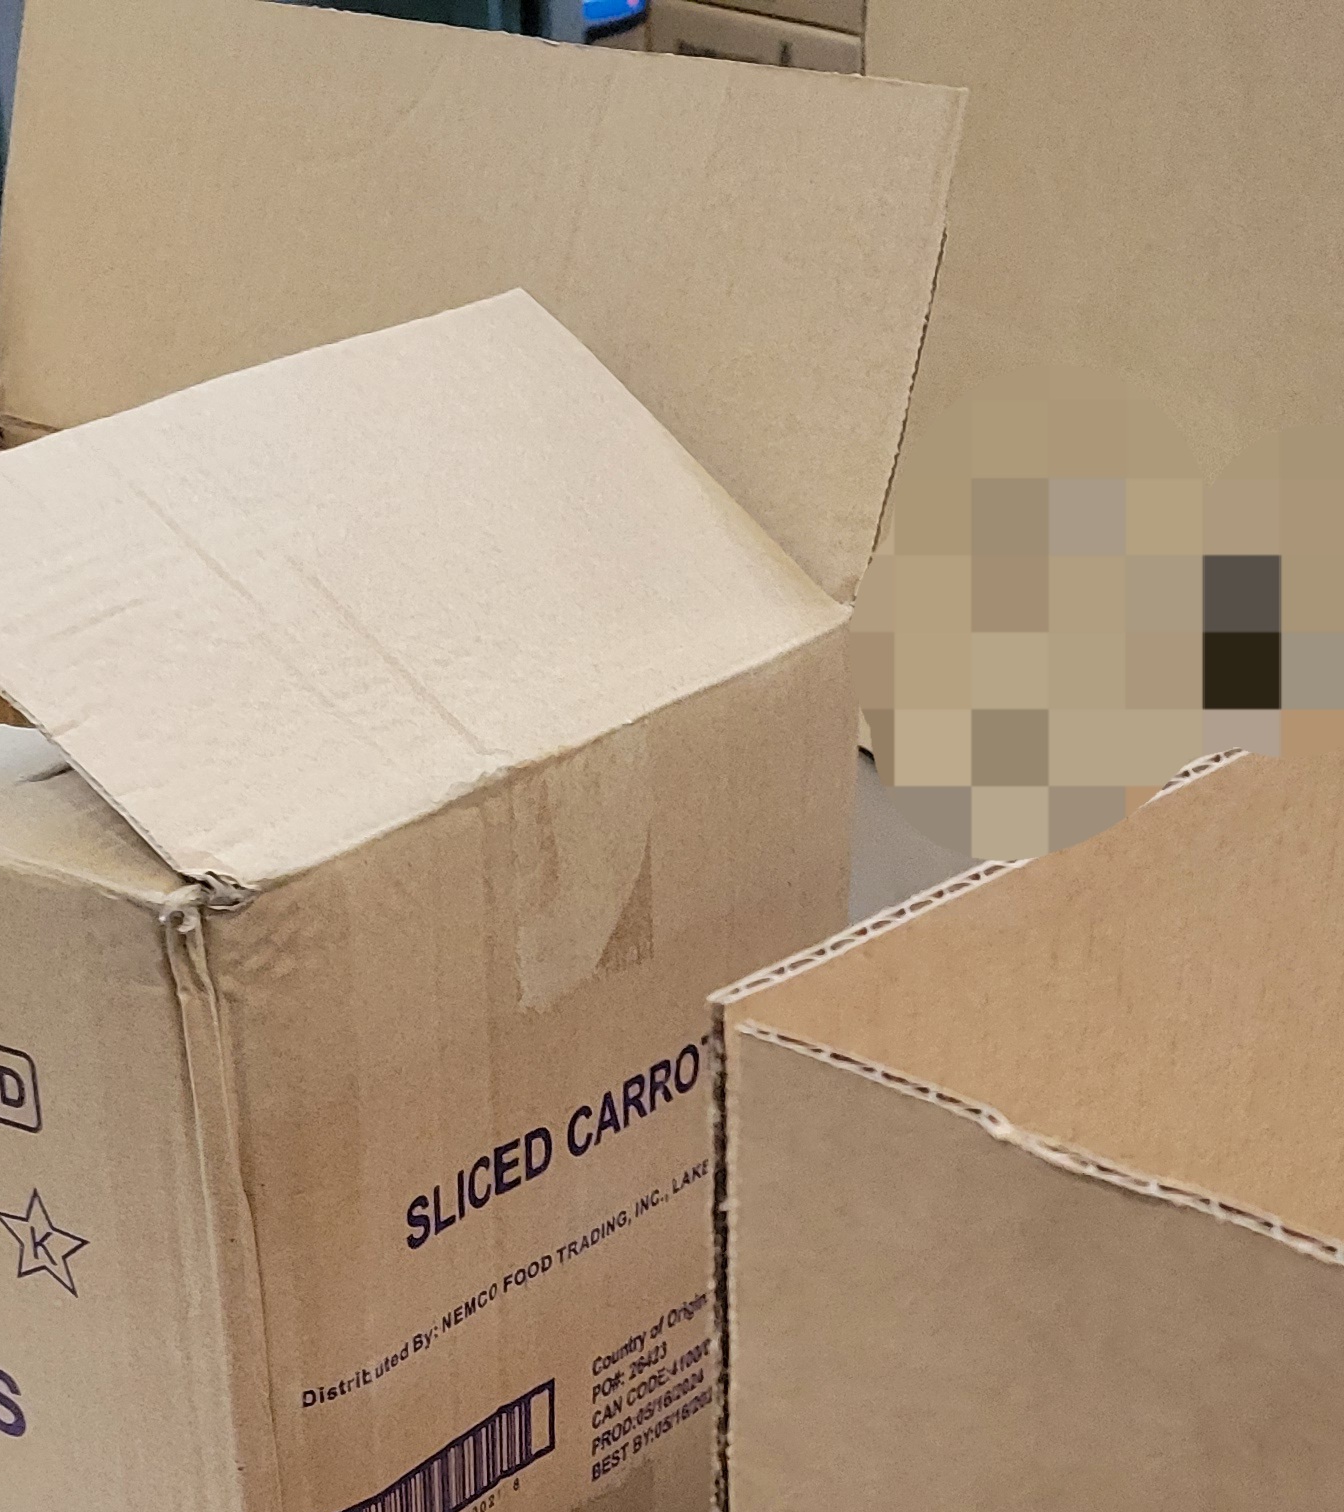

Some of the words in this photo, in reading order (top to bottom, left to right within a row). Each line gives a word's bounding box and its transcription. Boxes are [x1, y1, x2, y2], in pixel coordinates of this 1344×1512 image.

[405, 1126, 553, 1251] SLICED
[566, 1034, 711, 1157] CARRO
[29, 1227, 58, 1265] K
[412, 1325, 439, 1353] By:
[441, 1282, 499, 1334] NEMCO
[502, 1254, 553, 1294] FOOD
[556, 1210, 632, 1264] TRADING,
[671, 1158, 710, 1194] LAKE
[591, 1330, 648, 1377] Country
[649, 1314, 665, 1340] of
[591, 1395, 623, 1430] CAN
[591, 1441, 630, 1482] BEST
